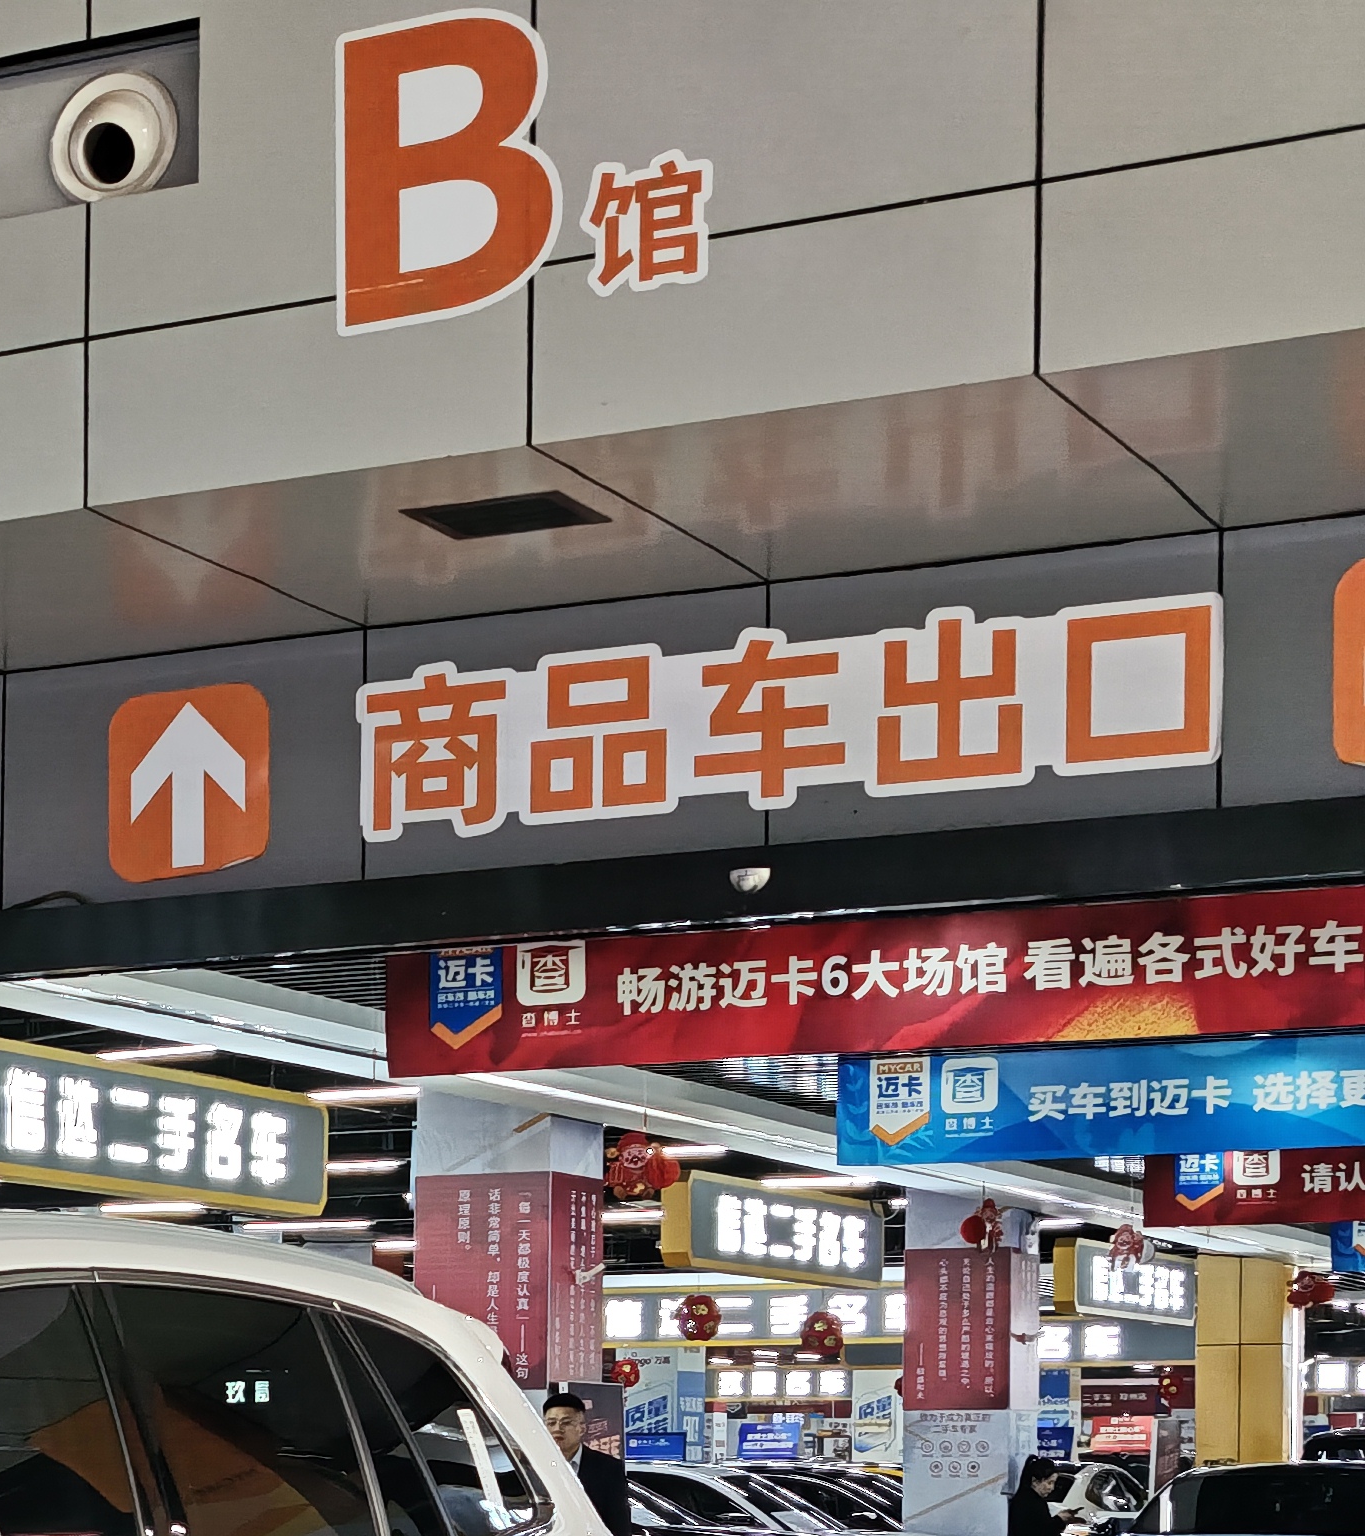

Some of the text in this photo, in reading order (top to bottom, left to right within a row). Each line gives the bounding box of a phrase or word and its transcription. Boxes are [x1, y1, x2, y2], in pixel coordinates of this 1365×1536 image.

[341, 15, 706, 330] B 馆
[361, 600, 1220, 837] 商品车出口
[437, 956, 495, 989] 迈卡
[616, 920, 1365, 1017] 畅游迈卡6大场馆 看遍各式好车
[876, 1075, 923, 1099] 迈卡
[878, 1063, 922, 1074] MYCAR
[1027, 1077, 1233, 1123] 买车到迈卡
[5, 1066, 288, 1186] 信达二手名车
[1179, 1154, 1220, 1173] 迈卡
